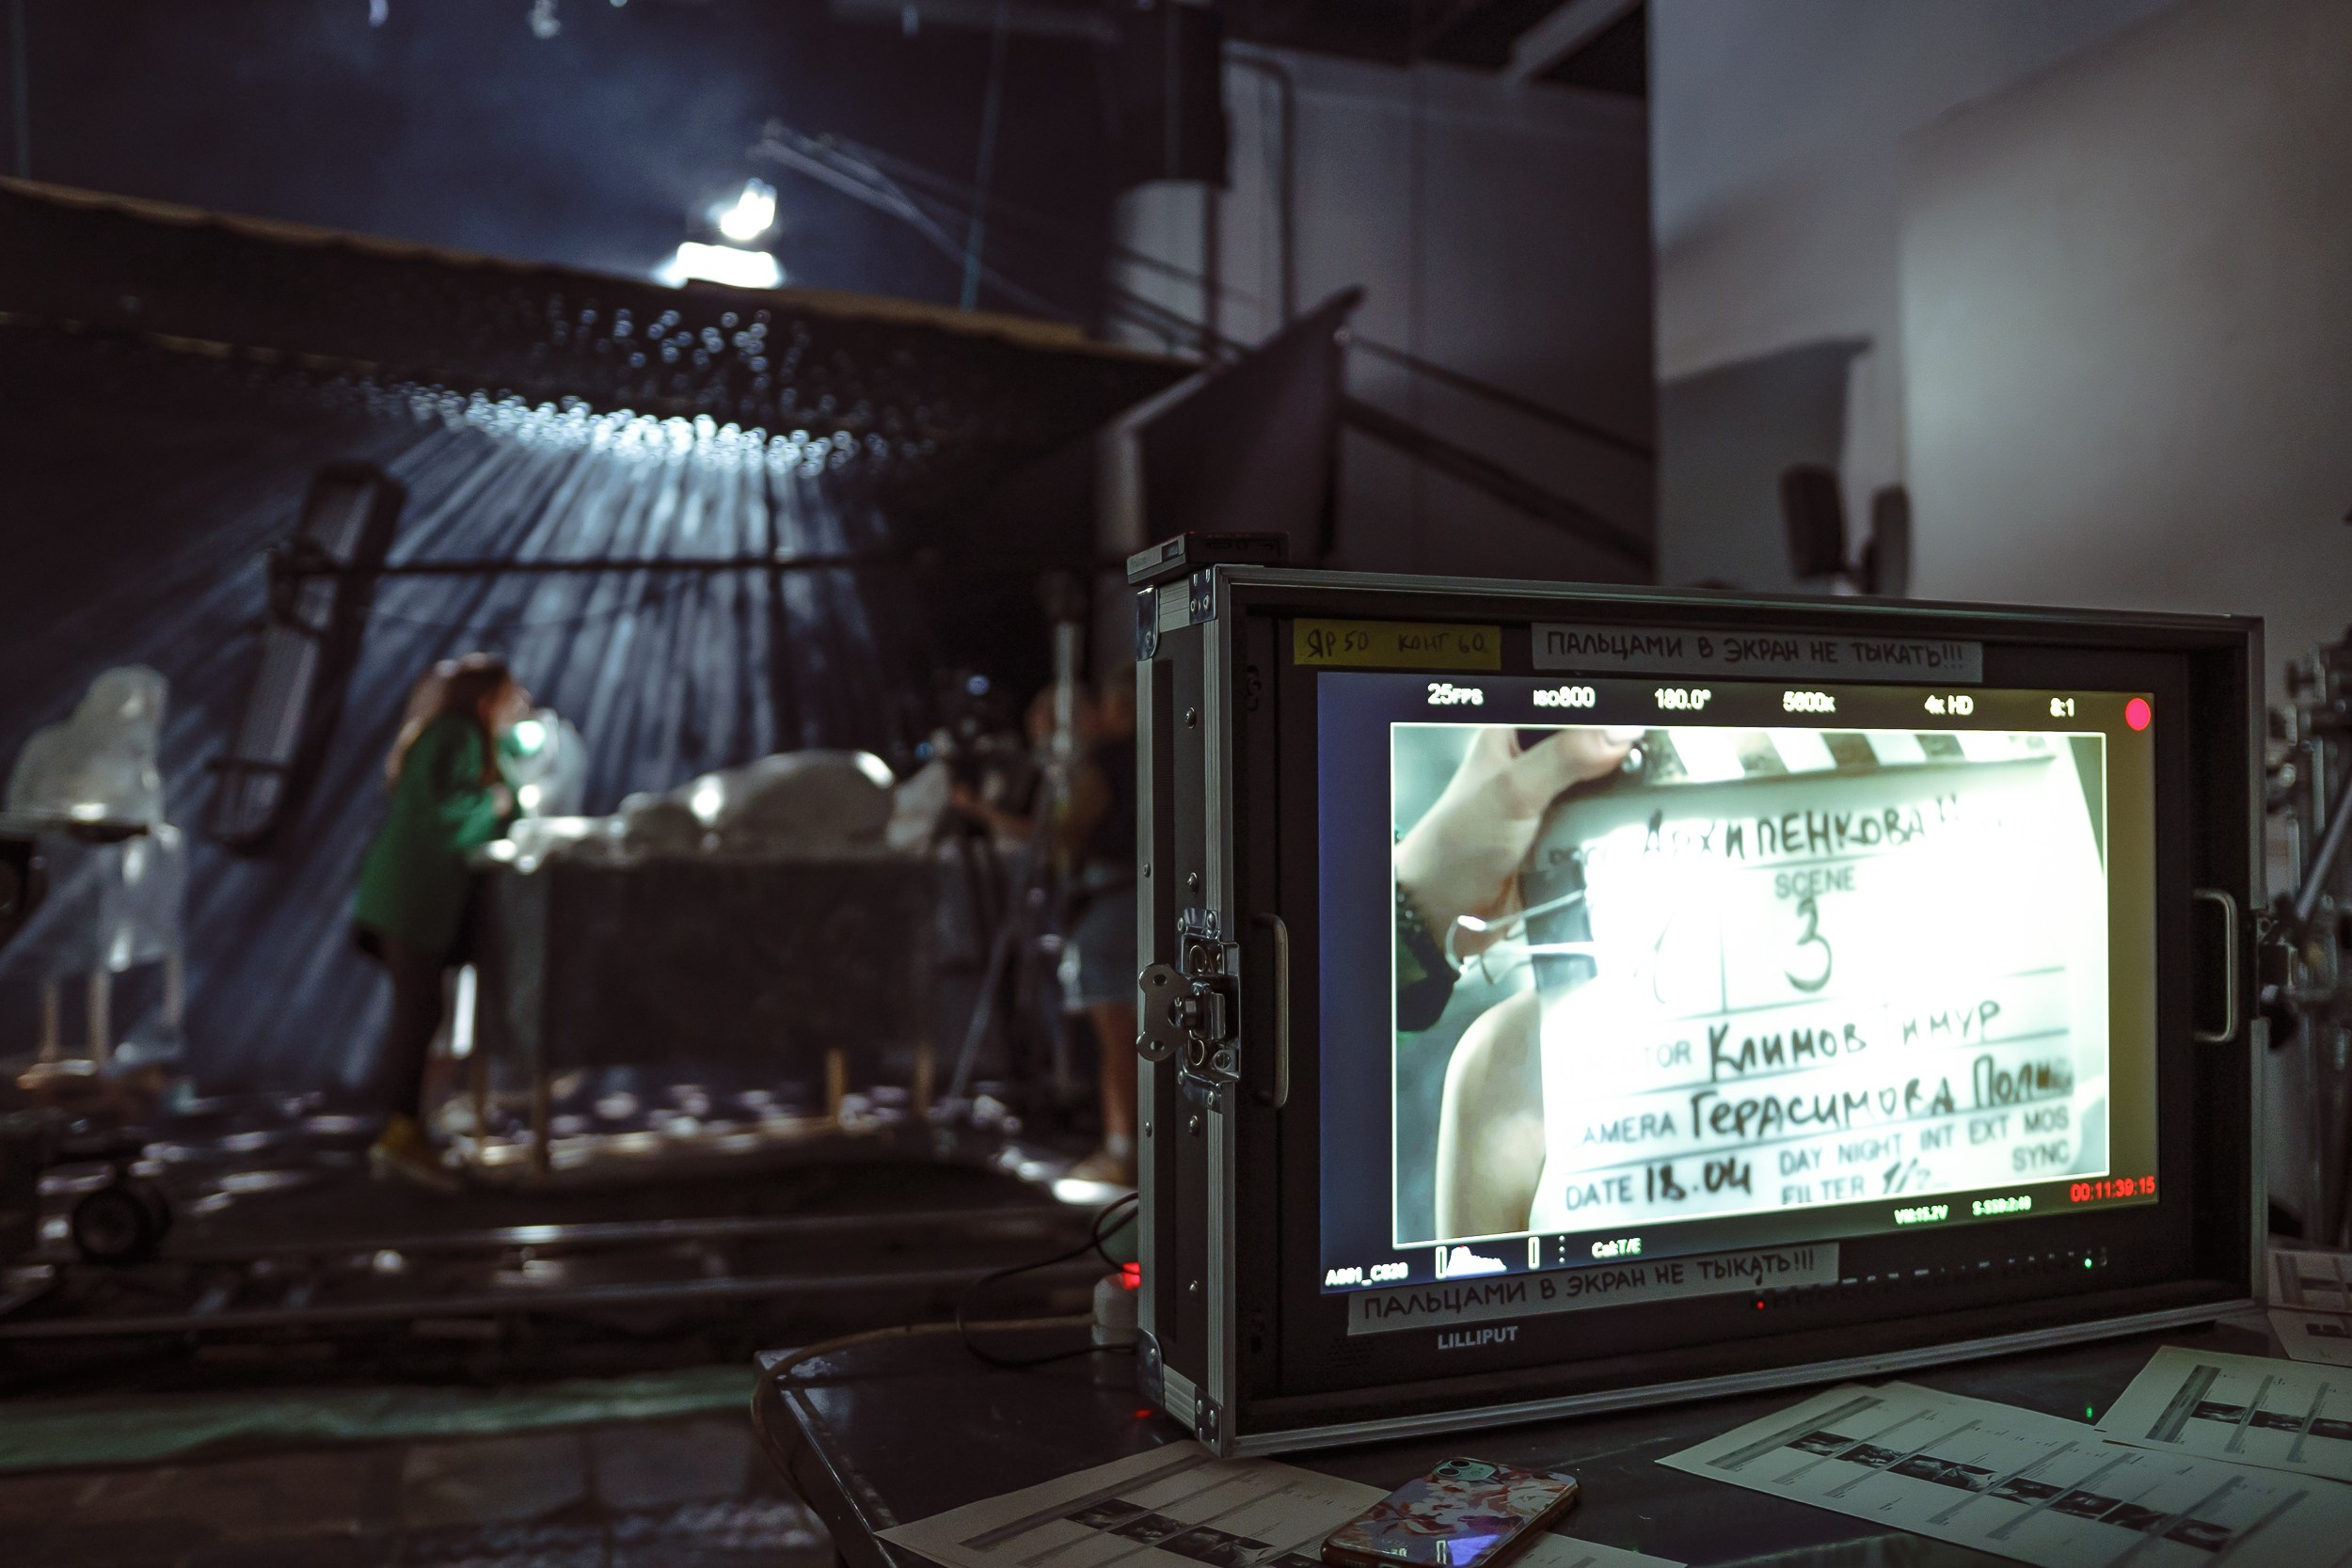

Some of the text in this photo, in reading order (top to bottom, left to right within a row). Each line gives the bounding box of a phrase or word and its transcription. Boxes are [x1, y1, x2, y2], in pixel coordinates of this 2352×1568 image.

[1547, 631, 1963, 669] ПАЛЬЦАМИ В ЭКРАН НЕ ТЫКАТЬ!!!
[1947, 695, 1974, 715] HD
[1774, 865, 1855, 898] SCENE
[1569, 1111, 1678, 1149] AMERA
[1778, 1103, 2071, 1177] DAY NIGHT INT EXT MOS
[2011, 1137, 2070, 1174] SYNC
[1565, 1174, 1635, 1212] DATE
[1364, 1281, 1526, 1319] ПАЛЬЦАМИ
[1540, 1277, 1556, 1300] В
[1566, 1267, 1645, 1298] ЭКРАН
[1654, 1261, 1684, 1285] НЕ
[1437, 1325, 1519, 1351] LILLIPUT
